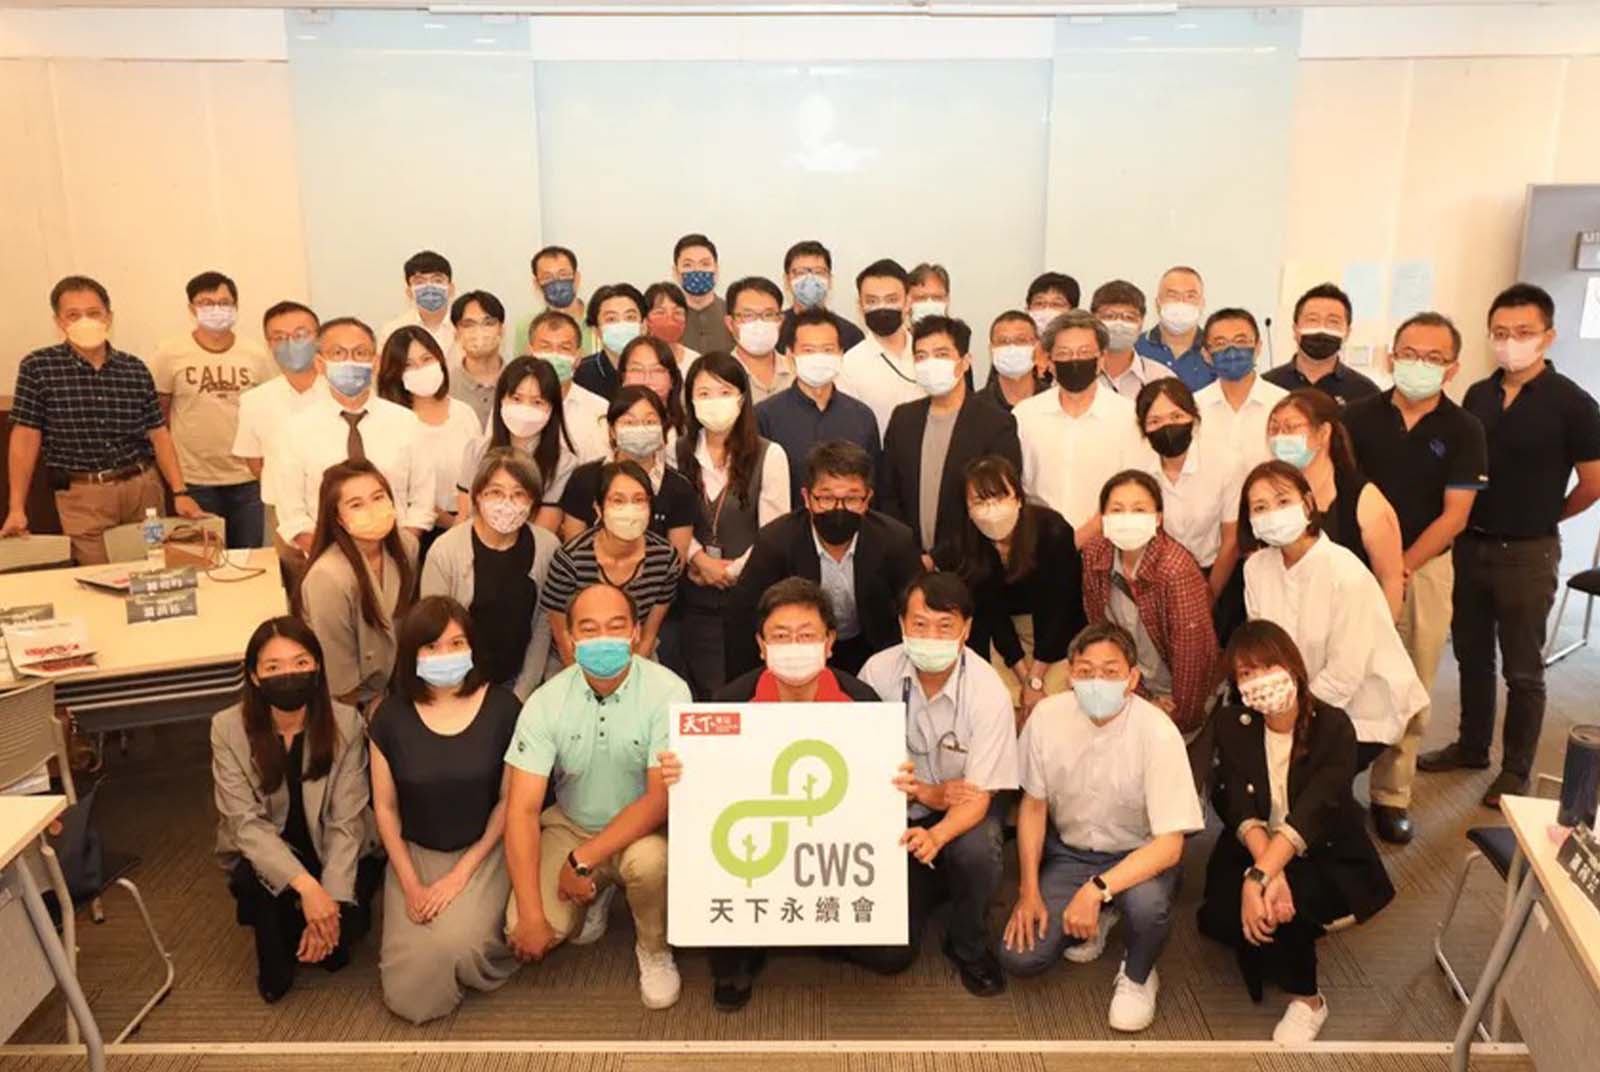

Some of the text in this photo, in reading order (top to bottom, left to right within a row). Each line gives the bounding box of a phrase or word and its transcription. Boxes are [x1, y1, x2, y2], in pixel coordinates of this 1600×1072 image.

[793, 842, 875, 888] CWS
[709, 896, 876, 924] 天下永續會
